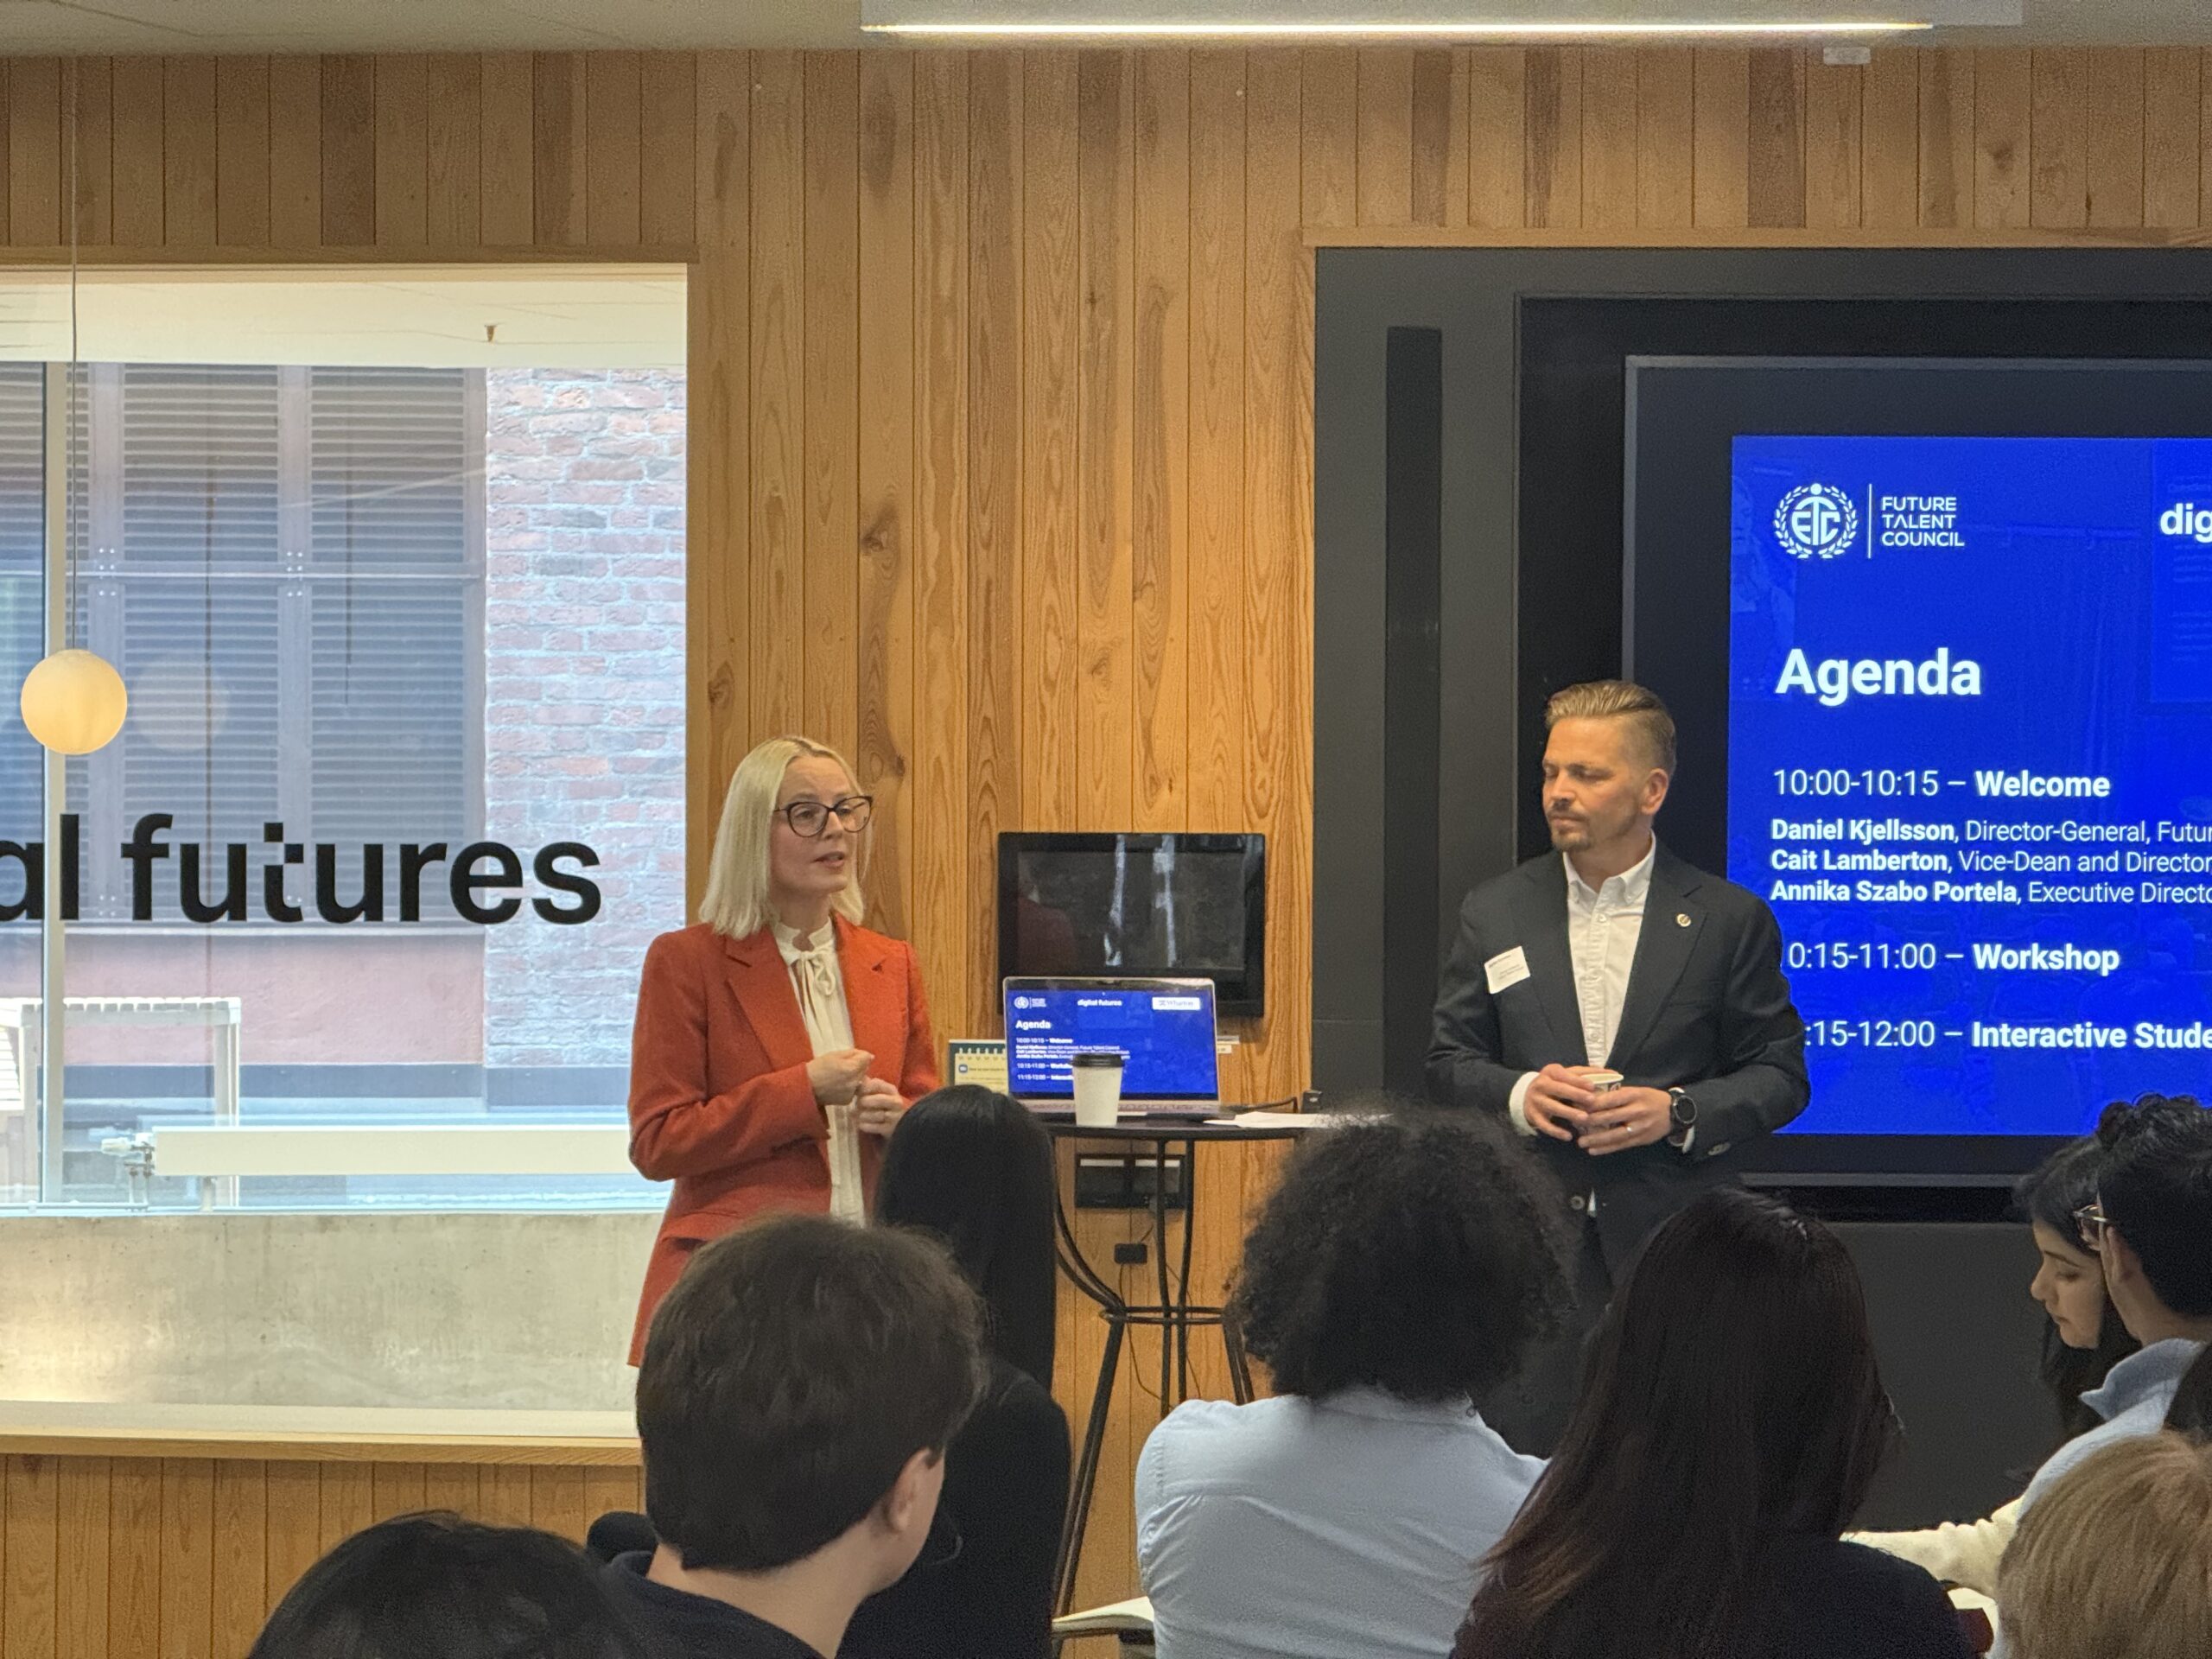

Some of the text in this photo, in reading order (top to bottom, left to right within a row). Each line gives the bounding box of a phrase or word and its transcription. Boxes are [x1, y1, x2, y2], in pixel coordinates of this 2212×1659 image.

[1881, 496, 1957, 512] FUTURE
[1881, 513, 1956, 529] TALENT
[2159, 502, 2212, 543] dig
[1881, 531, 1965, 547] COUNCIL
[1775, 646, 1981, 707] Agenda
[1774, 769, 1939, 797] 10:00-10:15
[1974, 769, 2111, 798] Welcome
[1771, 818, 1844, 841] Daniel
[1849, 818, 1959, 846] Kjellsson,
[1966, 819, 2151, 845] Director-General,
[121, 813, 602, 925] futures
[1770, 849, 1818, 870] Cait
[1823, 849, 1953, 874] Lamberton,
[1958, 850, 2071, 872] Vice-Dean
[2077, 850, 2119, 873] and
[1770, 879, 1851, 901] Annika
[1856, 880, 1929, 902] Szabo
[1934, 880, 2022, 906] Portela,
[2029, 880, 2134, 903] Executive
[1789, 942, 1936, 969] 0:15-11:00
[1972, 942, 2120, 977] Workshop
[1015, 1019, 1052, 1031] Agenda
[1805, 1020, 1936, 1047] :15-12:00
[1972, 1020, 2127, 1048] Interactive
